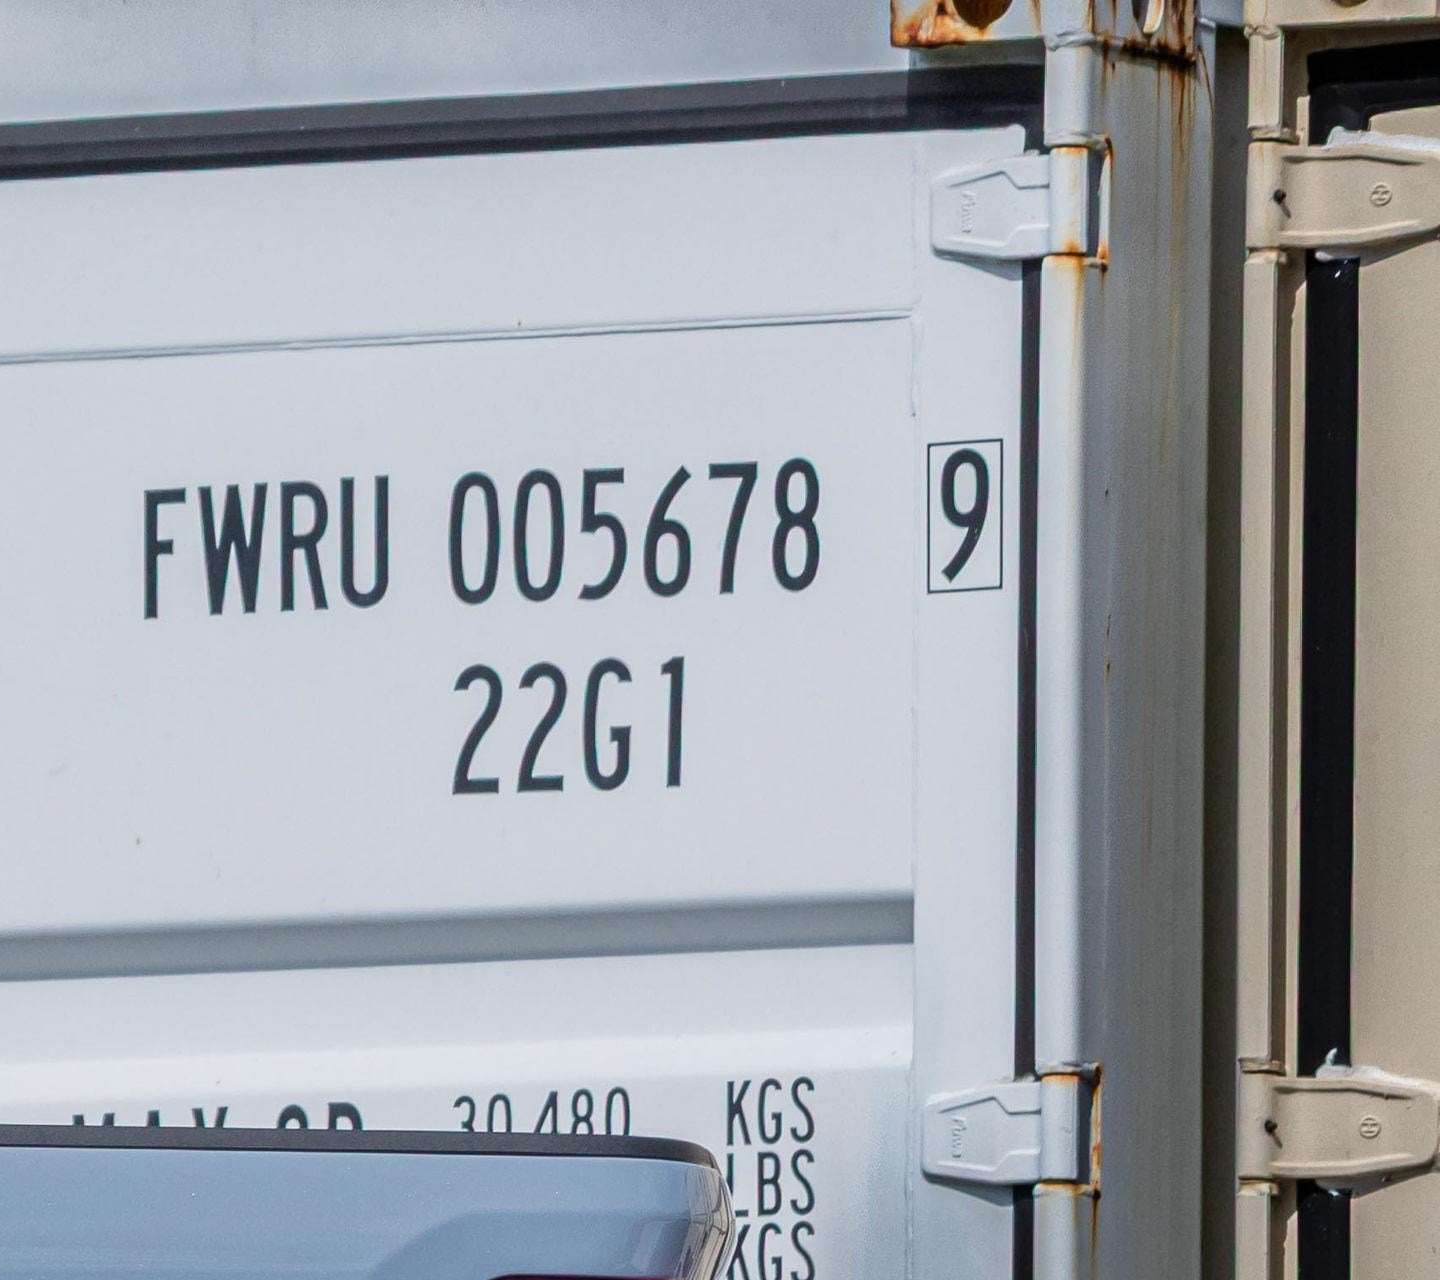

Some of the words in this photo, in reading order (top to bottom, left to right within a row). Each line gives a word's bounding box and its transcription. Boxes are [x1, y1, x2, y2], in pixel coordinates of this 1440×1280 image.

[145, 476, 389, 619] FWRU
[449, 458, 820, 604] 005678
[941, 448, 990, 582] 9
[453, 656, 684, 794] 22G1
[726, 1076, 815, 1146] KGS
[727, 1149, 815, 1216] LBS
